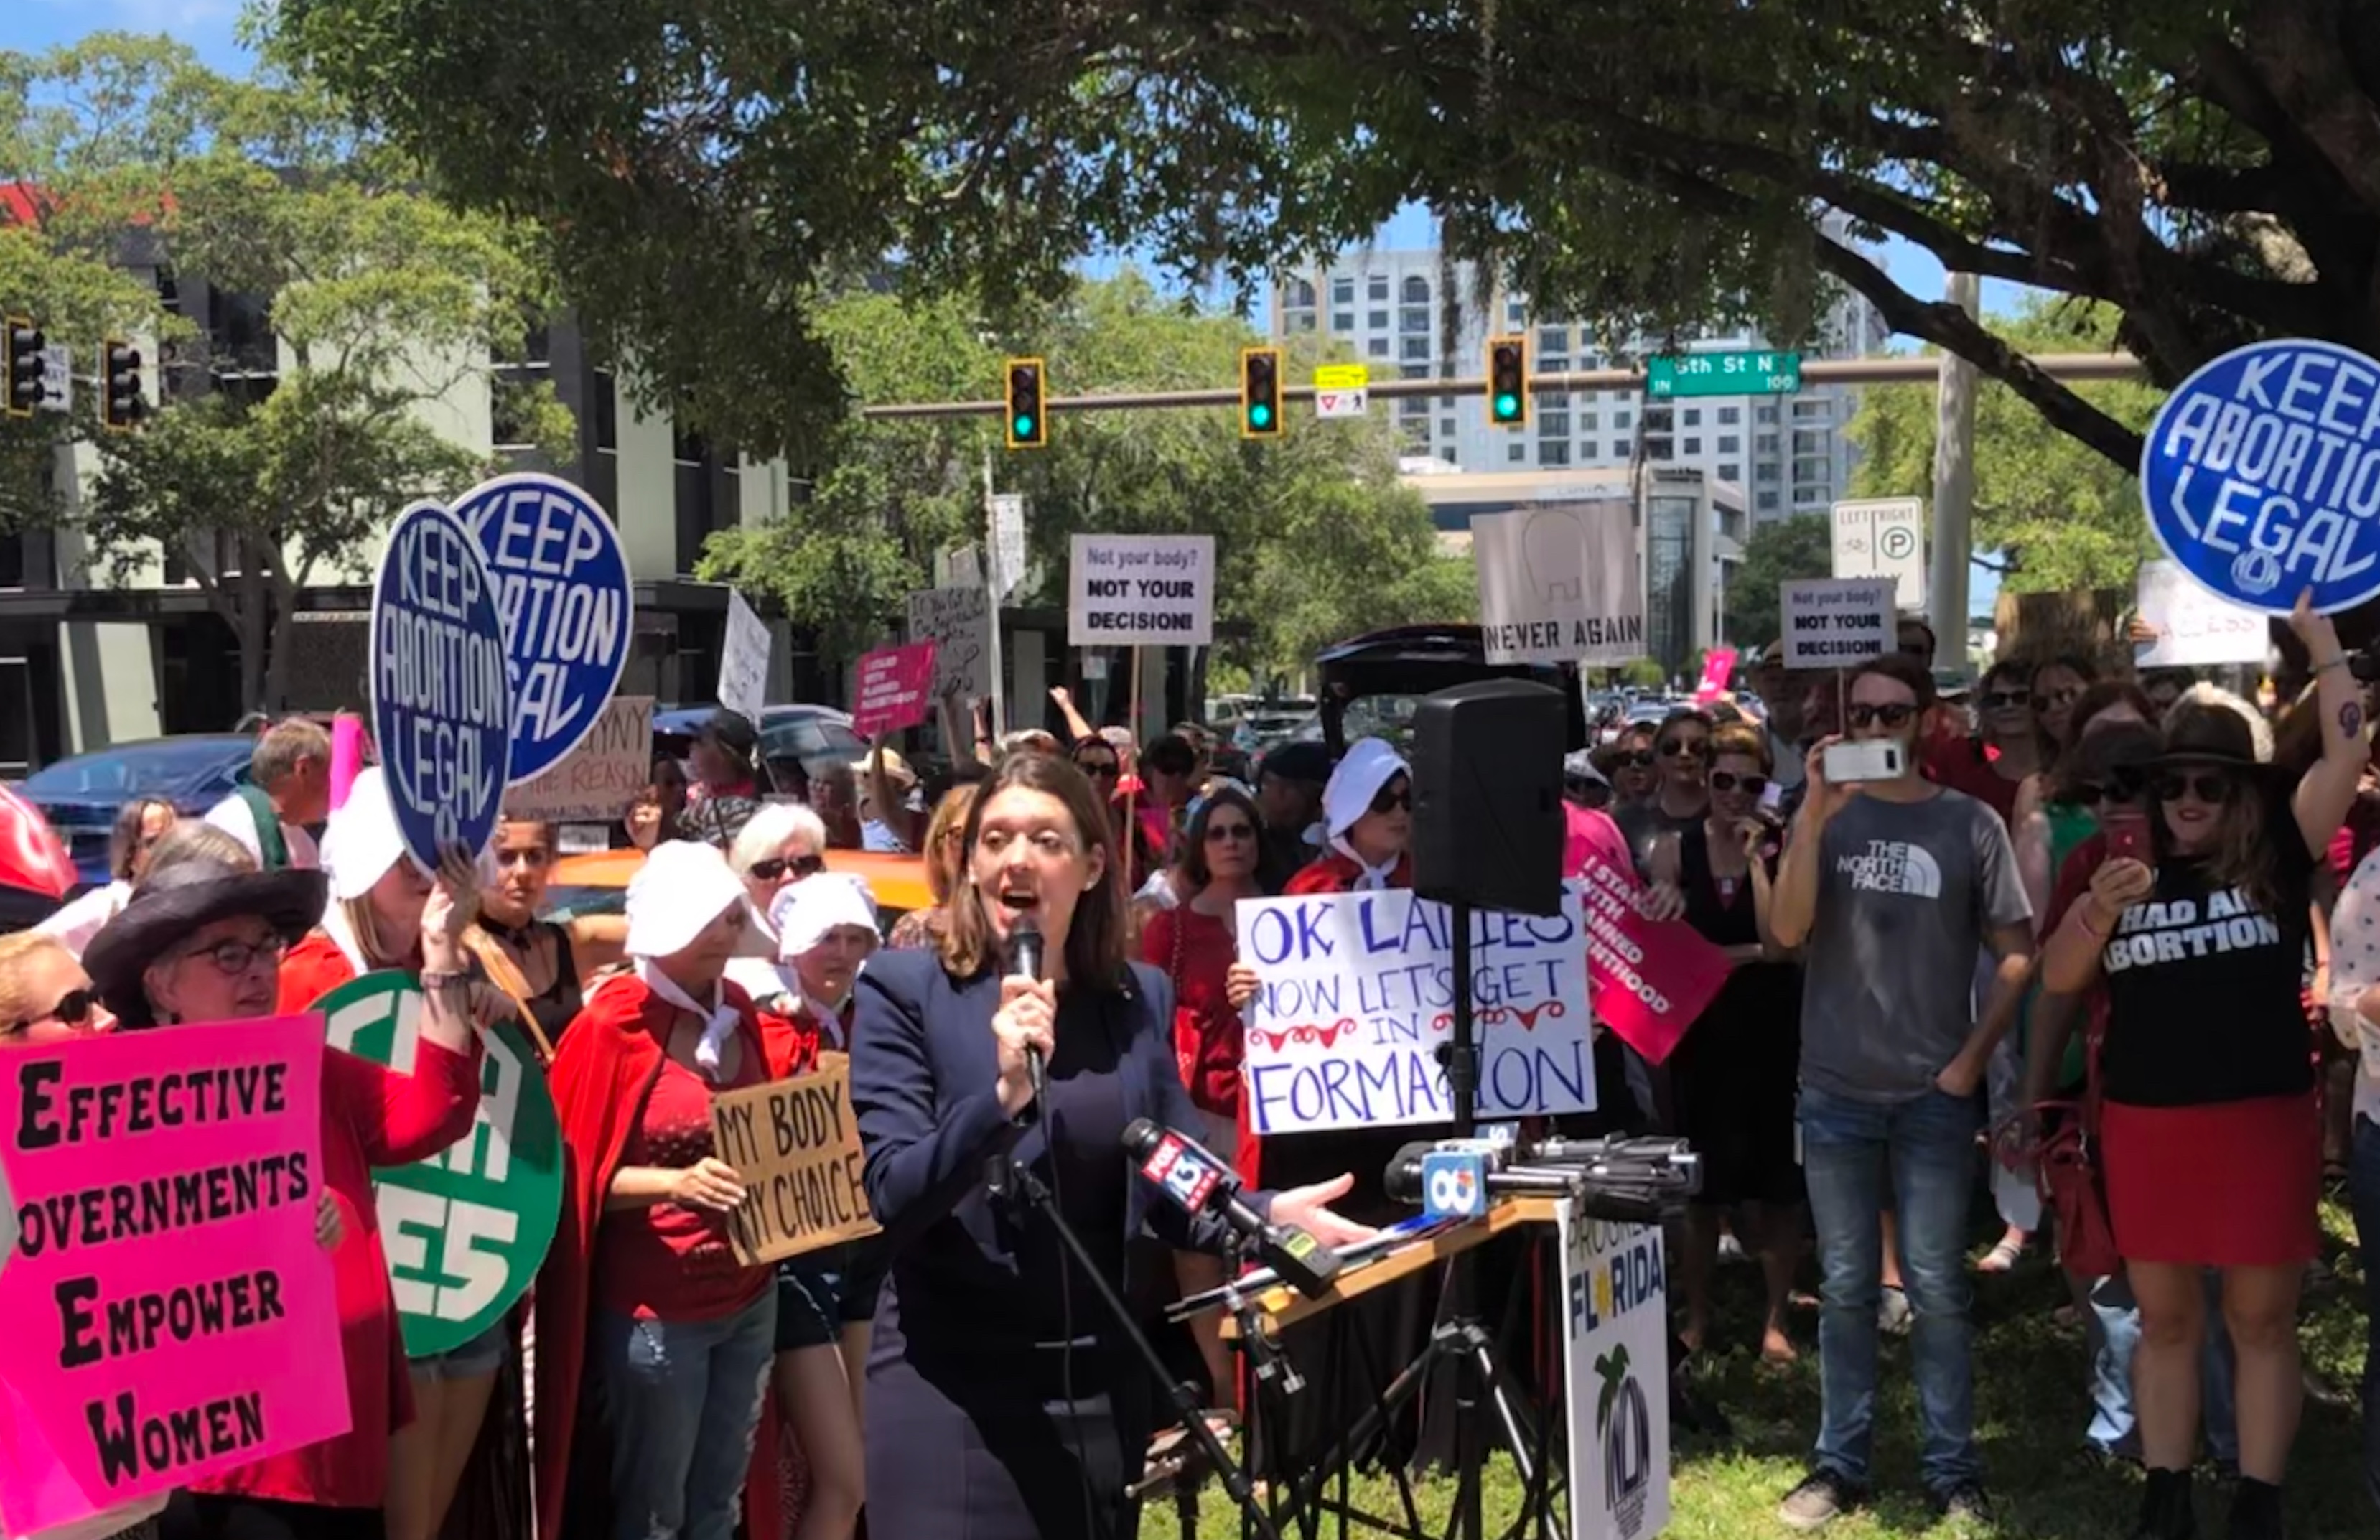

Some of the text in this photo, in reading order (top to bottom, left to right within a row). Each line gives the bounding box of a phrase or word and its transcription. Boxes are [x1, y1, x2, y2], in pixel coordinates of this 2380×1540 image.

[1723, 355, 1747, 373] St
[1758, 355, 1773, 372] N
[2164, 392, 2380, 519] ABORTIO
[466, 491, 602, 577] KEEP
[1840, 510, 1868, 526] LEFT
[2170, 465, 2379, 583] LEGAL
[399, 518, 481, 623] KEEP
[1088, 548, 1198, 570] Not your body?
[1088, 579, 1194, 599] NOT YOUR
[1792, 588, 1882, 607] Not your body?
[1088, 612, 1193, 630] DECISION!
[1483, 615, 1641, 650] NEVER AGAIN
[1794, 614, 1881, 630] NOT YOUR
[381, 602, 504, 730] ABORTION
[1797, 639, 1882, 656] DECISION!
[393, 710, 494, 822] LEGAL
[1837, 854, 1905, 875] NORTH
[1867, 839, 1907, 858] THE
[1852, 872, 1903, 892] FACE
[1251, 902, 1335, 964] OK
[2118, 899, 2197, 933] HAD
[2104, 913, 2280, 974] BORTION
[1259, 974, 1340, 1019] NOW
[1472, 958, 1565, 1005] GET
[1369, 1012, 1419, 1045] IN
[17, 1060, 287, 1150] EFFECTIVE
[717, 1080, 844, 1166] MY BODY
[1147, 1139, 1180, 1181] FOX
[18, 1151, 309, 1258] OVERNMENTS
[734, 1150, 871, 1255] MY CHOICE
[55, 1270, 285, 1369] EMPOWER
[86, 1390, 266, 1488] WOMEN
